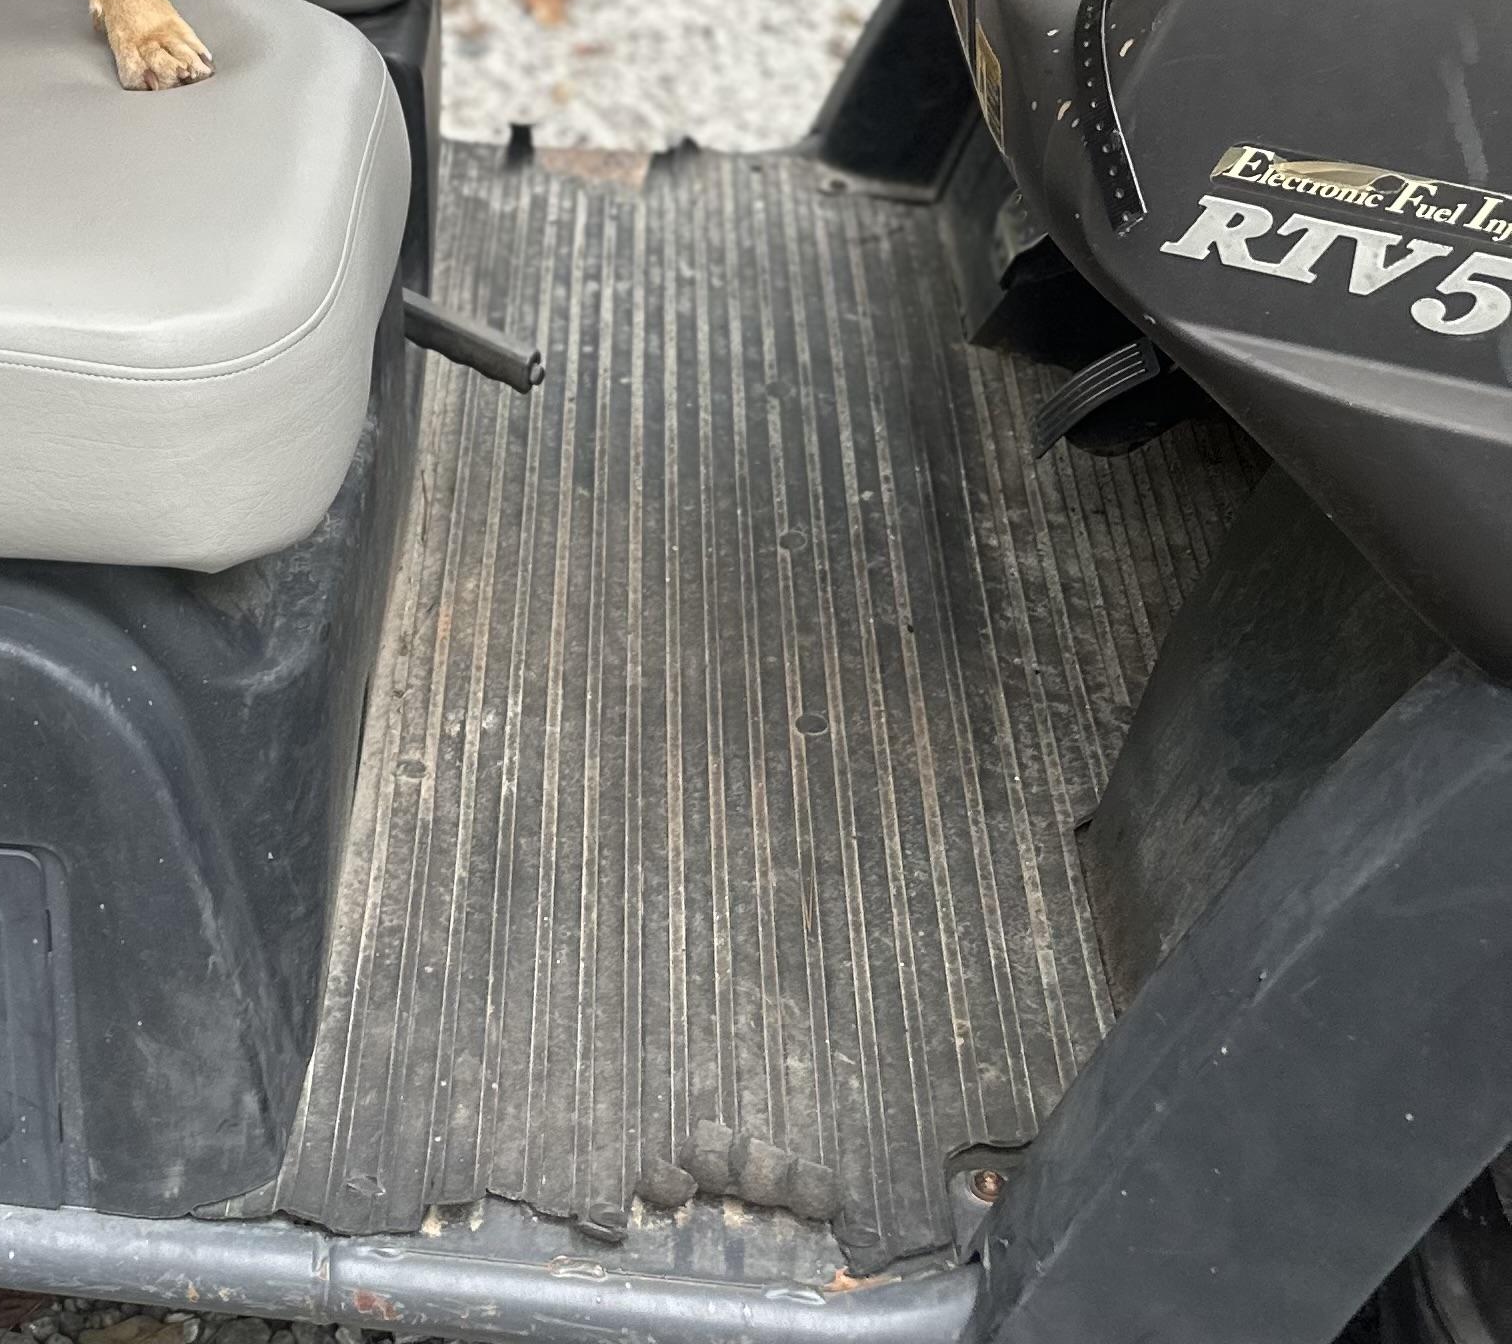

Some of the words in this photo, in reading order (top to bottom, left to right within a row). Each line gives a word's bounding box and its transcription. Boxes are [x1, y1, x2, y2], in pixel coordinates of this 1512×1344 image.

[1223, 146, 1384, 207] Electronic
[1385, 181, 1467, 224] Fuel
[1159, 195, 1512, 336] RTV5
